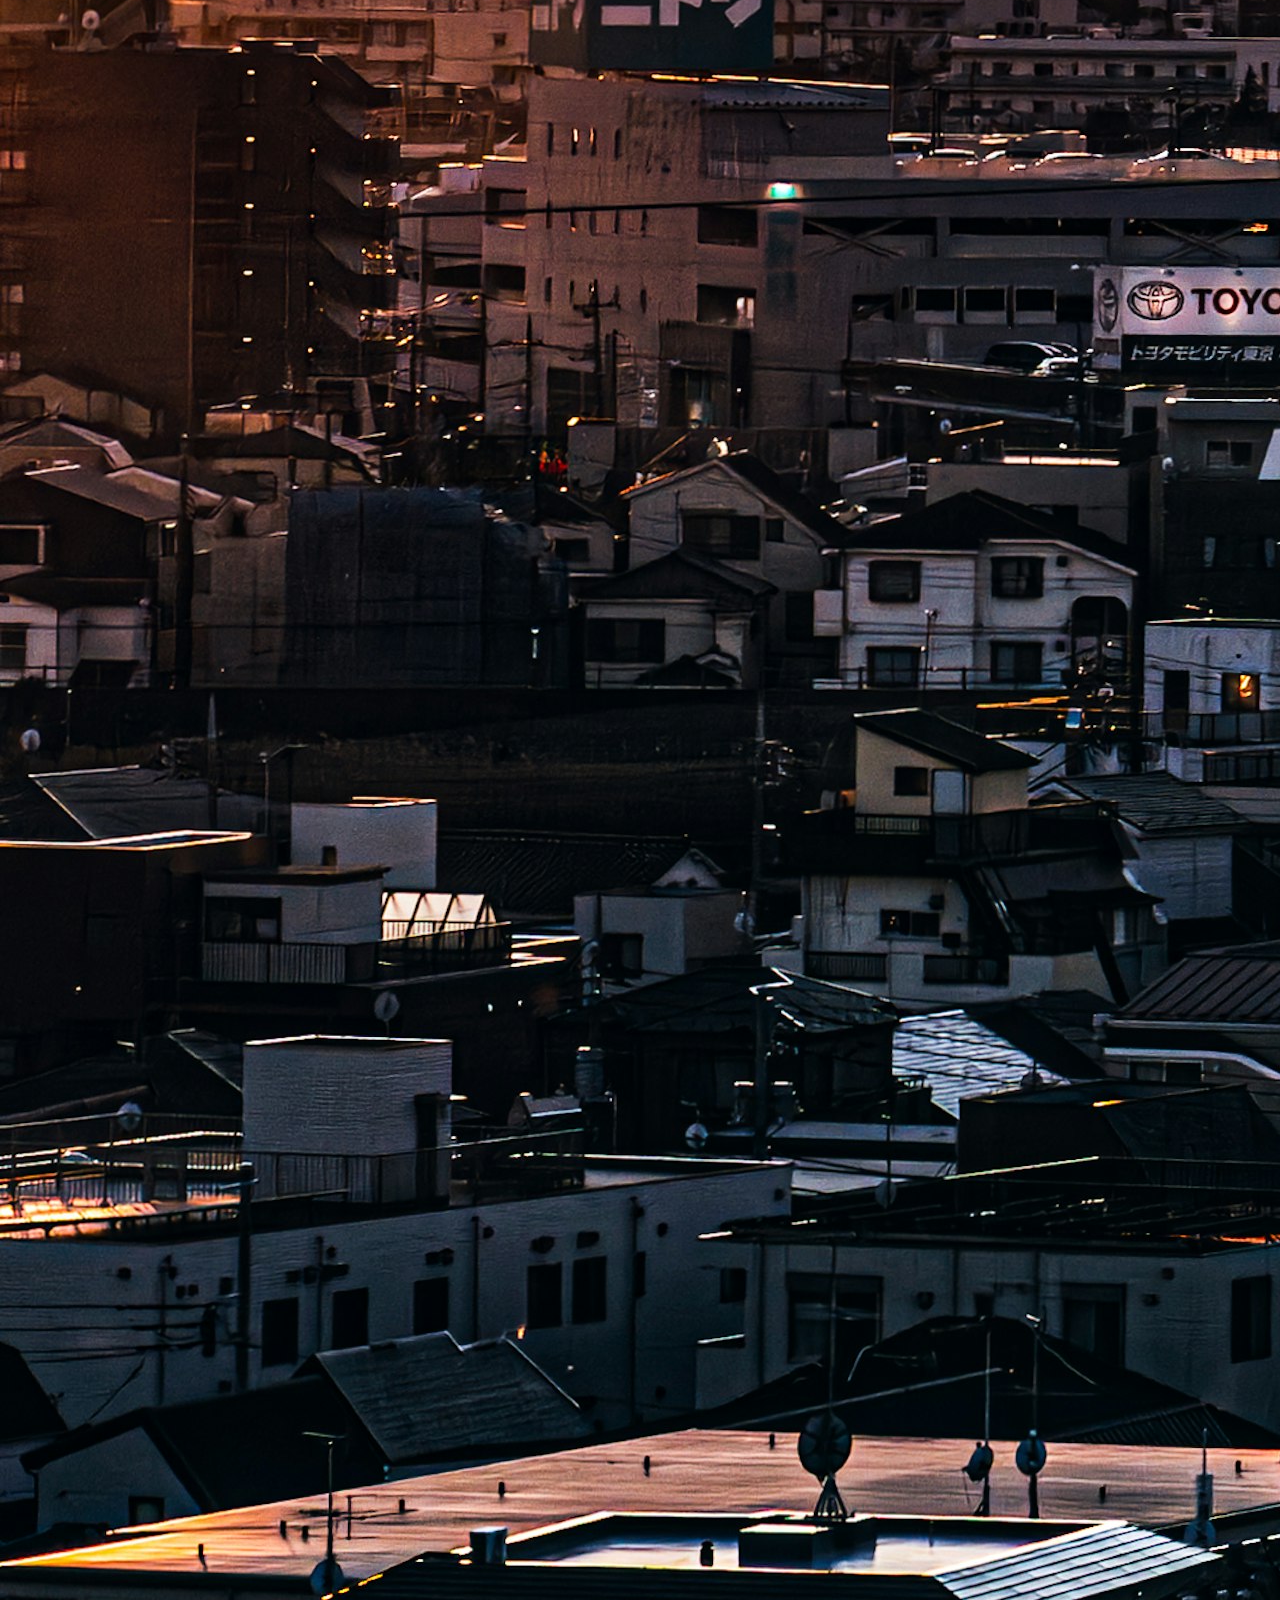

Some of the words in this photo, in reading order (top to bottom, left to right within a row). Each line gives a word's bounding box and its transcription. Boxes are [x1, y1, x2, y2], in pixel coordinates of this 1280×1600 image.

[1130, 345, 1274, 363] トヨタモビリティ東京
